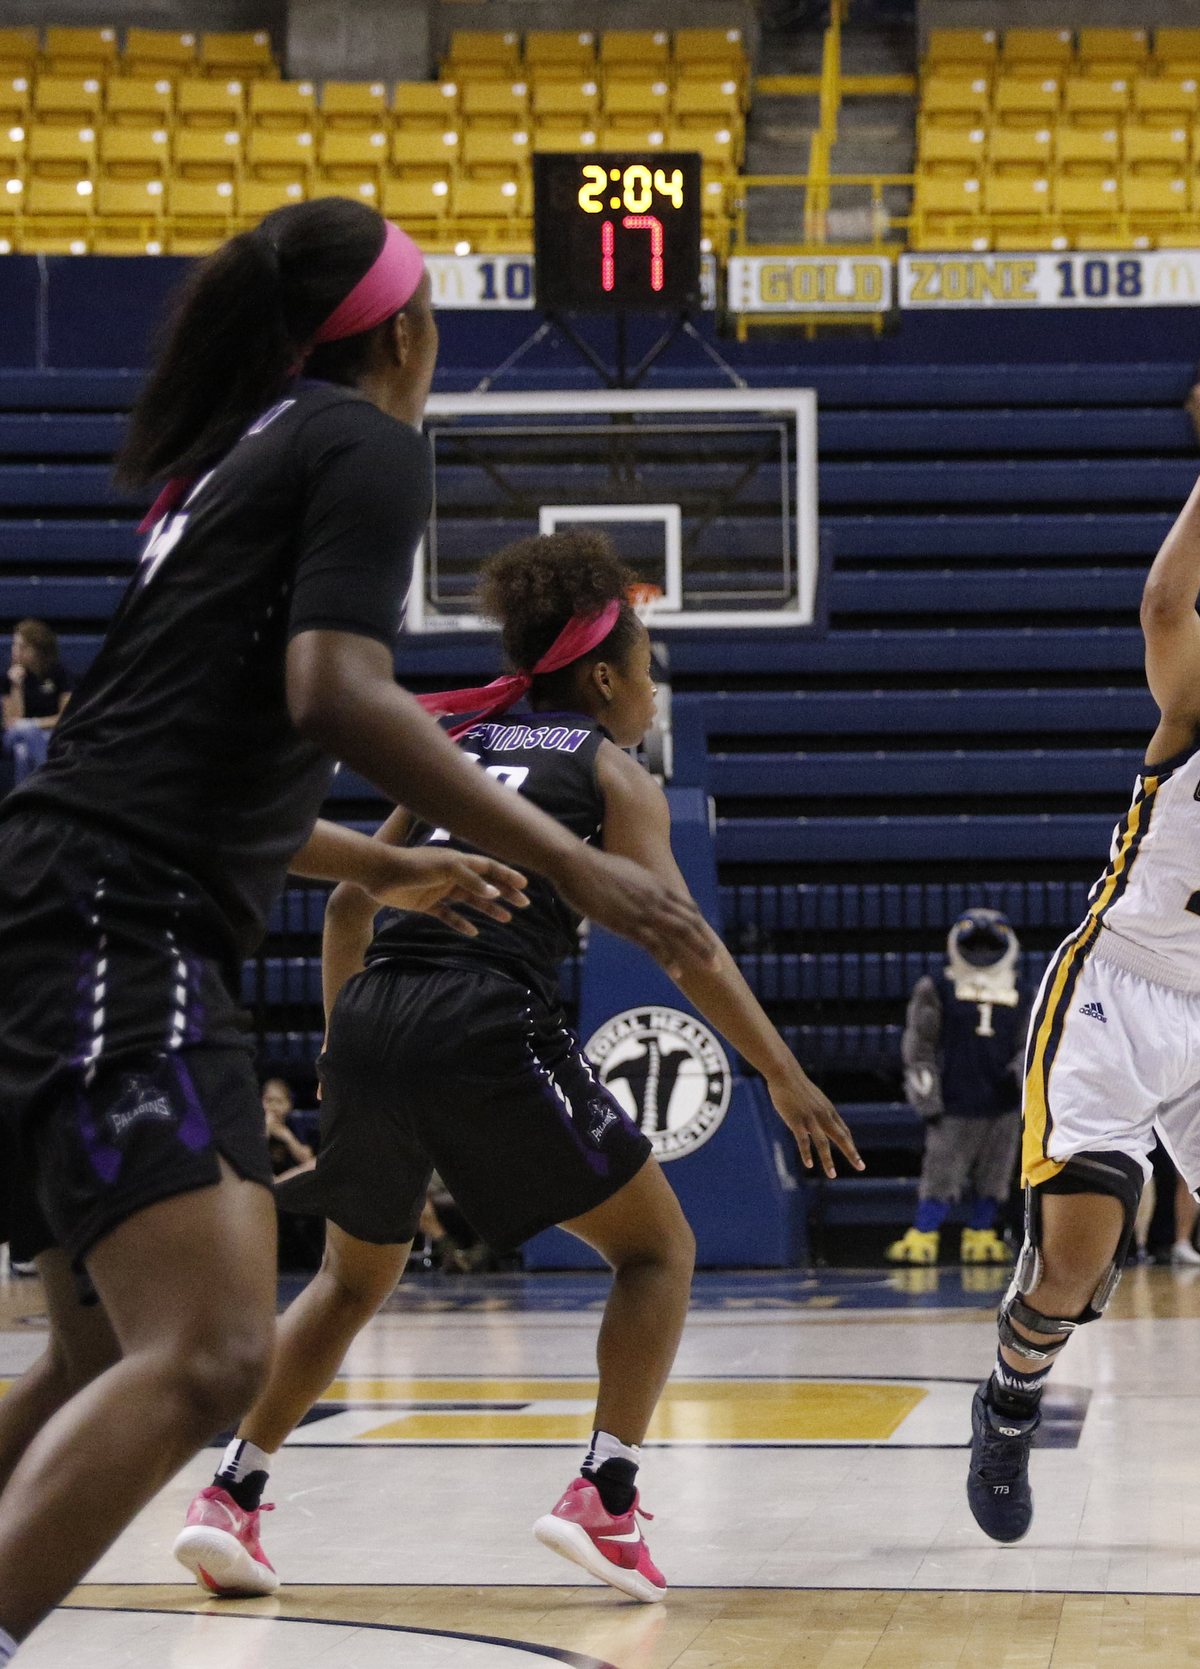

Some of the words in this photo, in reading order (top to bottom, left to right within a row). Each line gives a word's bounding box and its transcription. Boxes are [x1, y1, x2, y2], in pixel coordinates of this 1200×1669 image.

[579, 164, 684, 214] 2:04
[601, 215, 664, 292] 17
[479, 262, 531, 300] 10
[760, 264, 883, 303] GOLD
[909, 261, 1038, 301] ZONE
[1057, 259, 1143, 298] 108
[466, 723, 592, 753] VIDSON
[1079, 1007, 1108, 1023] adidas
[651, 1011, 722, 1074] HEALTH
[111, 1097, 170, 1134] PALADINS
[993, 1485, 1010, 1495] 773
